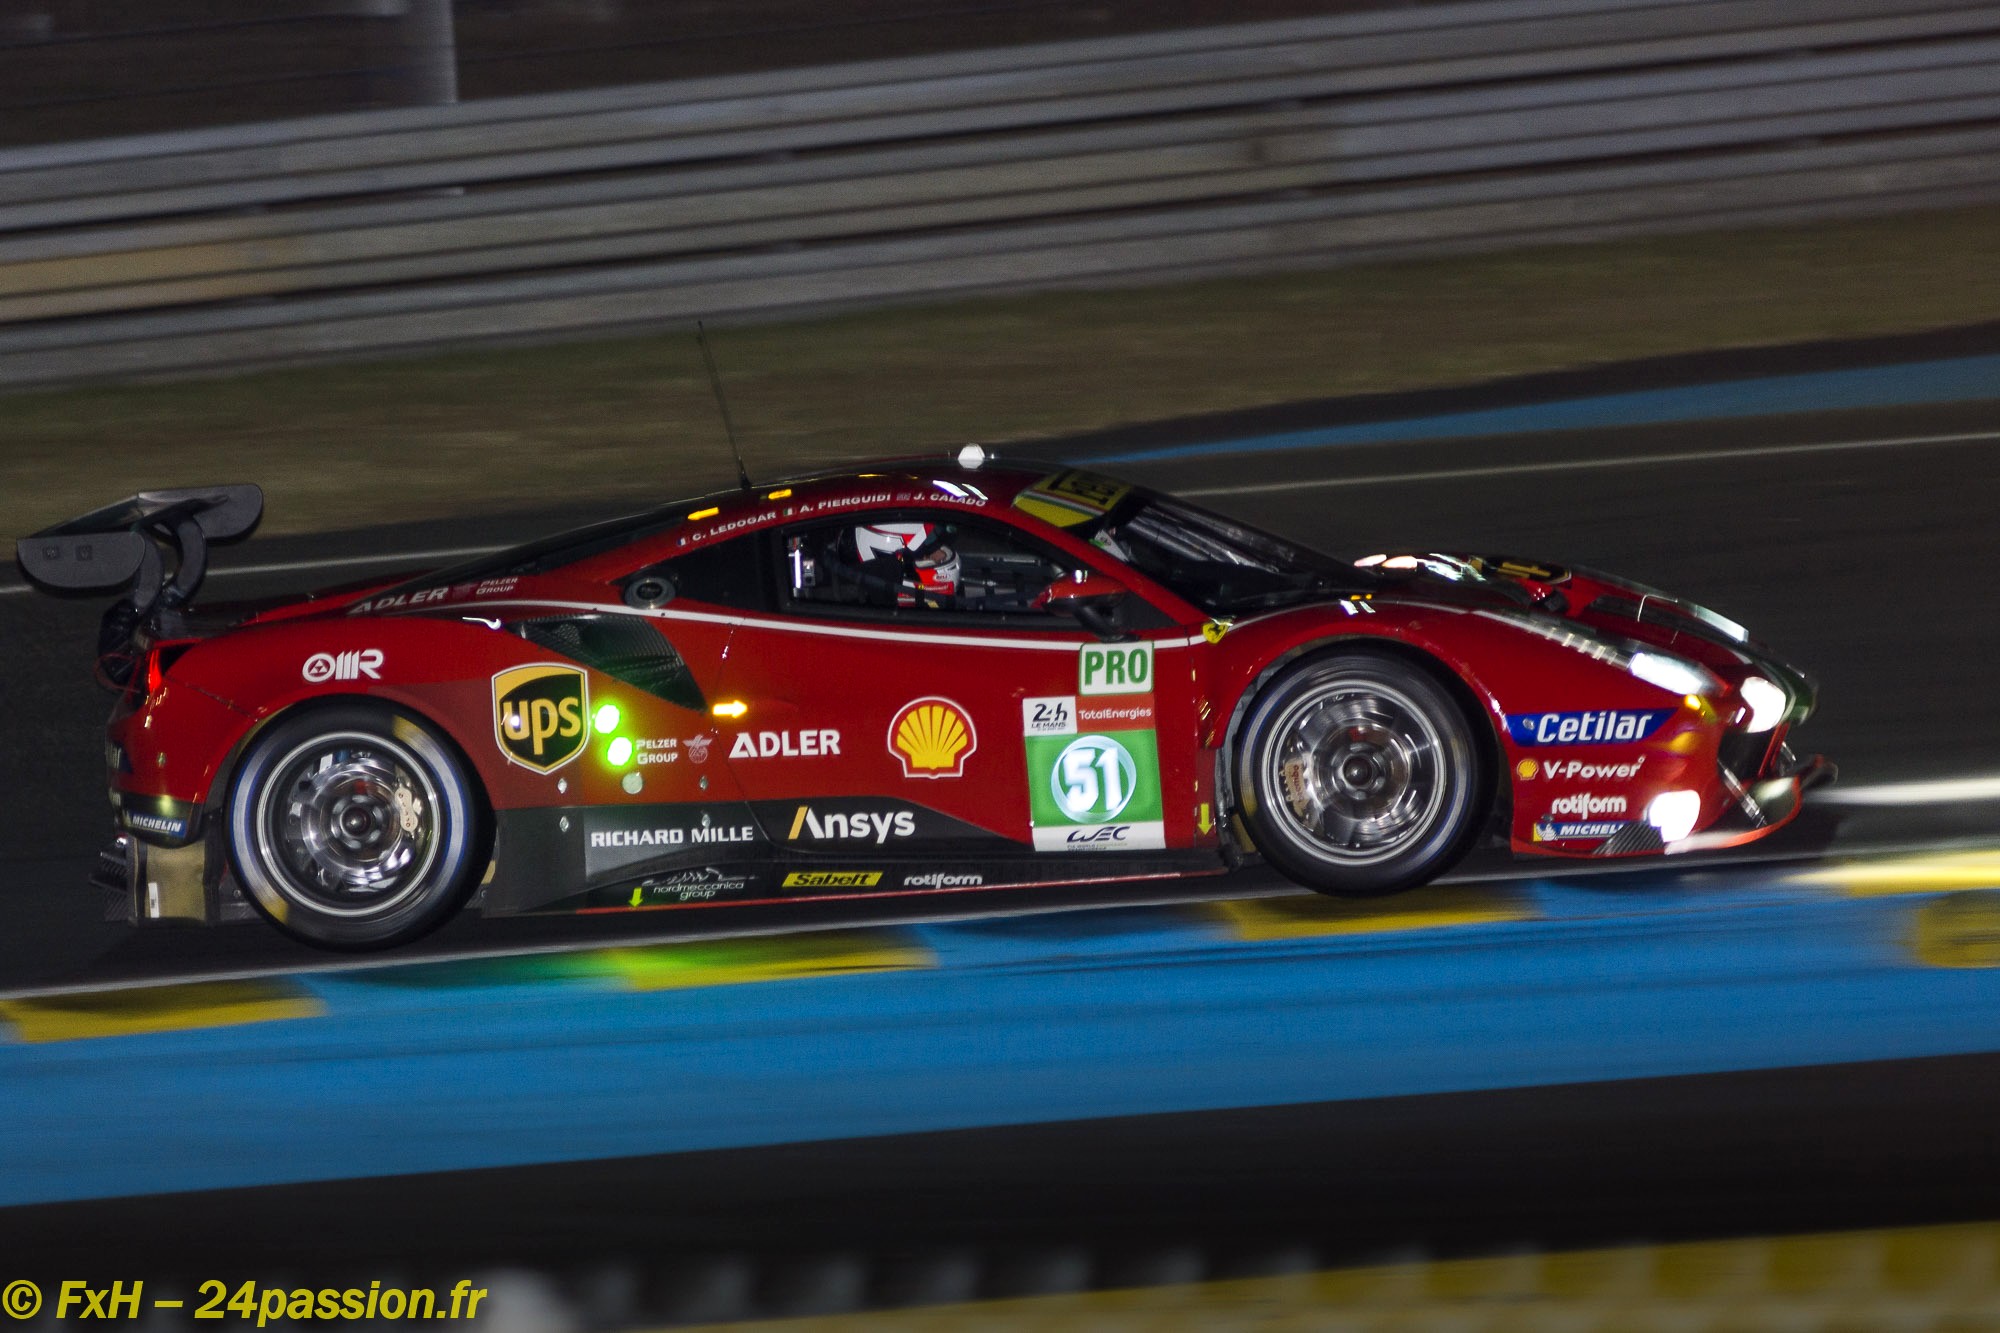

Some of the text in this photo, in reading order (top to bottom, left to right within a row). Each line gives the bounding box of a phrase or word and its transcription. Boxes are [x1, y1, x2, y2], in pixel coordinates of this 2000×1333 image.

[800, 493, 891, 513] A. PIERGUIDI
[930, 493, 986, 507] CALADO
[692, 512, 777, 541] C. LEDOGAR
[348, 587, 449, 614] ADLER
[475, 586, 514, 595] GROUP
[1084, 648, 1148, 686] PRO
[1032, 702, 1068, 722] 24h
[1078, 707, 1152, 720] TotalEnergies
[502, 696, 581, 755] ups
[1537, 711, 1653, 743] Cetilar
[636, 738, 677, 750] PELZER
[728, 729, 841, 759] ADLER
[637, 752, 678, 765] GROUP
[1543, 758, 1641, 779] V-Power
[1062, 747, 1123, 813] 51
[1551, 792, 1627, 820] rotiform
[132, 815, 182, 832] MICHELIN
[788, 805, 916, 844] Ansys
[1560, 823, 1625, 835] MICHEL
[590, 826, 754, 847] RICHARD MILLE
[1067, 826, 1131, 843] WEC
[653, 882, 745, 894] nordmeccanica
[793, 872, 871, 886] Sabelt
[904, 872, 983, 889] rotiform
[679, 890, 716, 901] group
